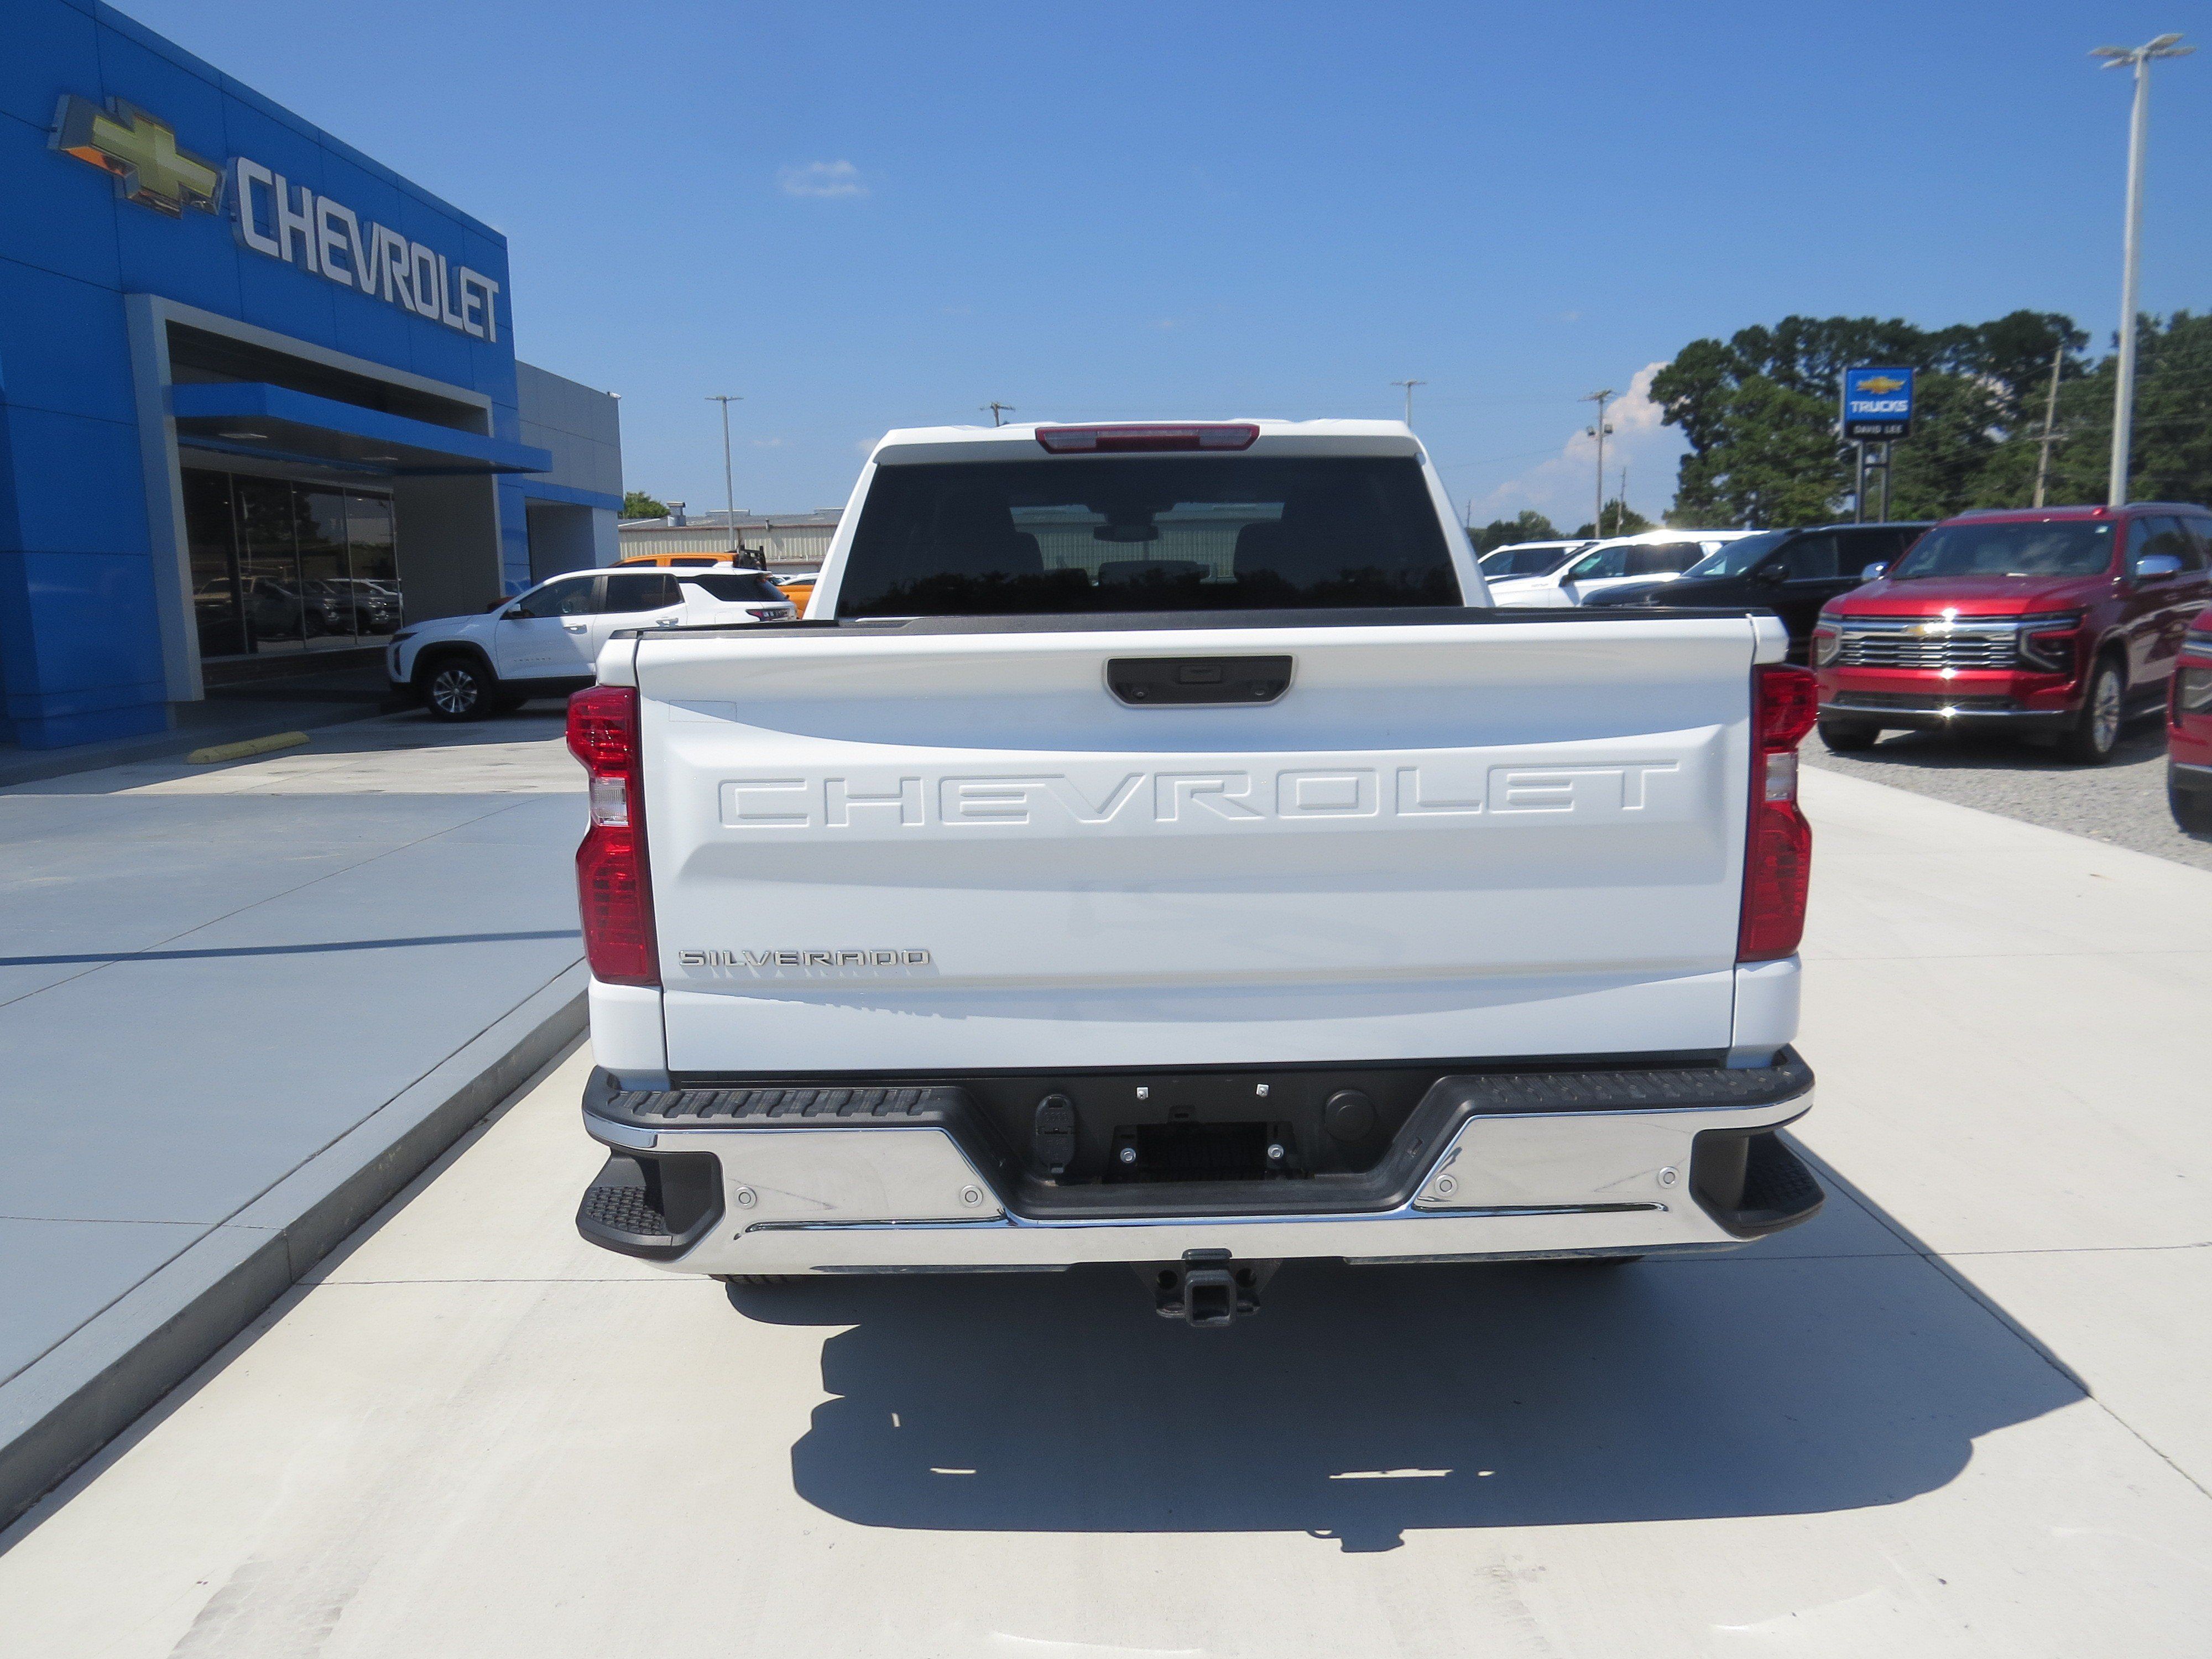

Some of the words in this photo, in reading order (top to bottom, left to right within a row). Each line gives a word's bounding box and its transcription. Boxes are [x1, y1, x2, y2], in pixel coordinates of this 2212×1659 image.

[236, 156, 499, 343] CHEVROLET
[1850, 400, 1908, 413] TRUCKS
[718, 759, 1680, 828] CHEVROLET
[678, 948, 930, 967] SILVERADO
